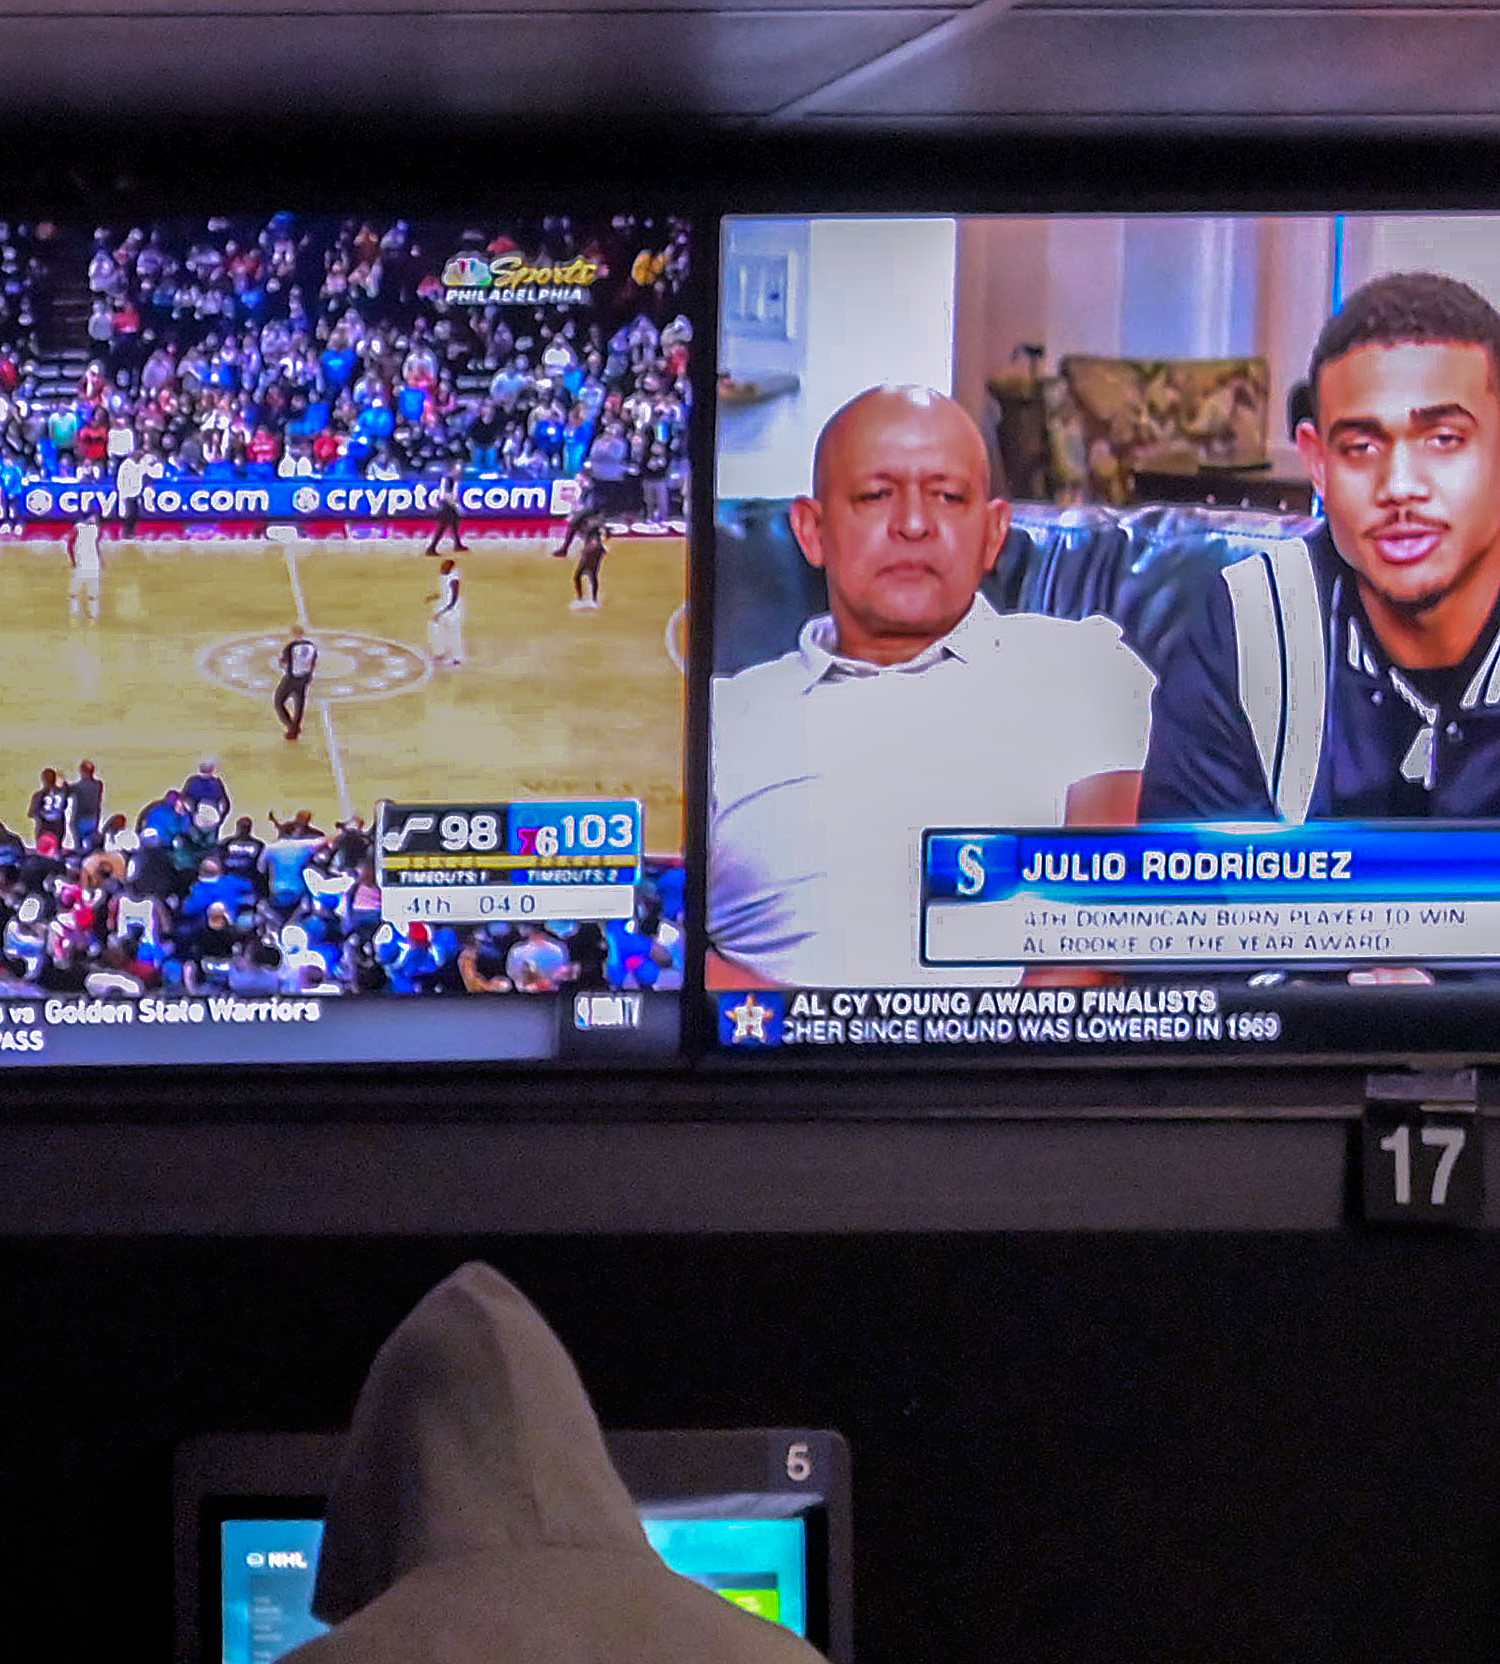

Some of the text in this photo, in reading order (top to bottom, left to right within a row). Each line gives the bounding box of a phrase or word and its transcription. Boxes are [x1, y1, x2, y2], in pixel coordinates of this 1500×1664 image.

[490, 256, 597, 288] Sports
[446, 288, 583, 302] PHILADELPHIA
[326, 483, 547, 517] cryptcom
[441, 814, 498, 850] 98
[561, 814, 633, 848] 103
[956, 843, 986, 895] S
[1022, 844, 1353, 882] JULIO RODRÍGUEZ
[1076, 910, 1207, 928] DOMINICAN
[1216, 910, 1279, 927] BORN
[1288, 909, 1373, 927] PLAYER
[1384, 909, 1410, 926] TO
[1419, 908, 1466, 926] WIN
[1022, 934, 1390, 954] AL ROOKIE OF THE YEAR AWARD
[9, 1005, 35, 1025] vs
[45, 1000, 133, 1025] Golden
[138, 1000, 204, 1024] State
[209, 999, 321, 1024] Warriors
[790, 991, 1216, 1017] AL CY YOUNG AWARD FINALISTS
[848, 1019, 918, 1042] SINCE
[924, 1018, 1012, 1041] MOUND
[1019, 1018, 1071, 1040] WAS
[1075, 1017, 1190, 1040] LOWERED
[1196, 1017, 1220, 1039] IN
[1226, 1017, 1278, 1039] 1969
[1380, 1127, 1465, 1206] 17
[267, 1552, 307, 1569] NHL
